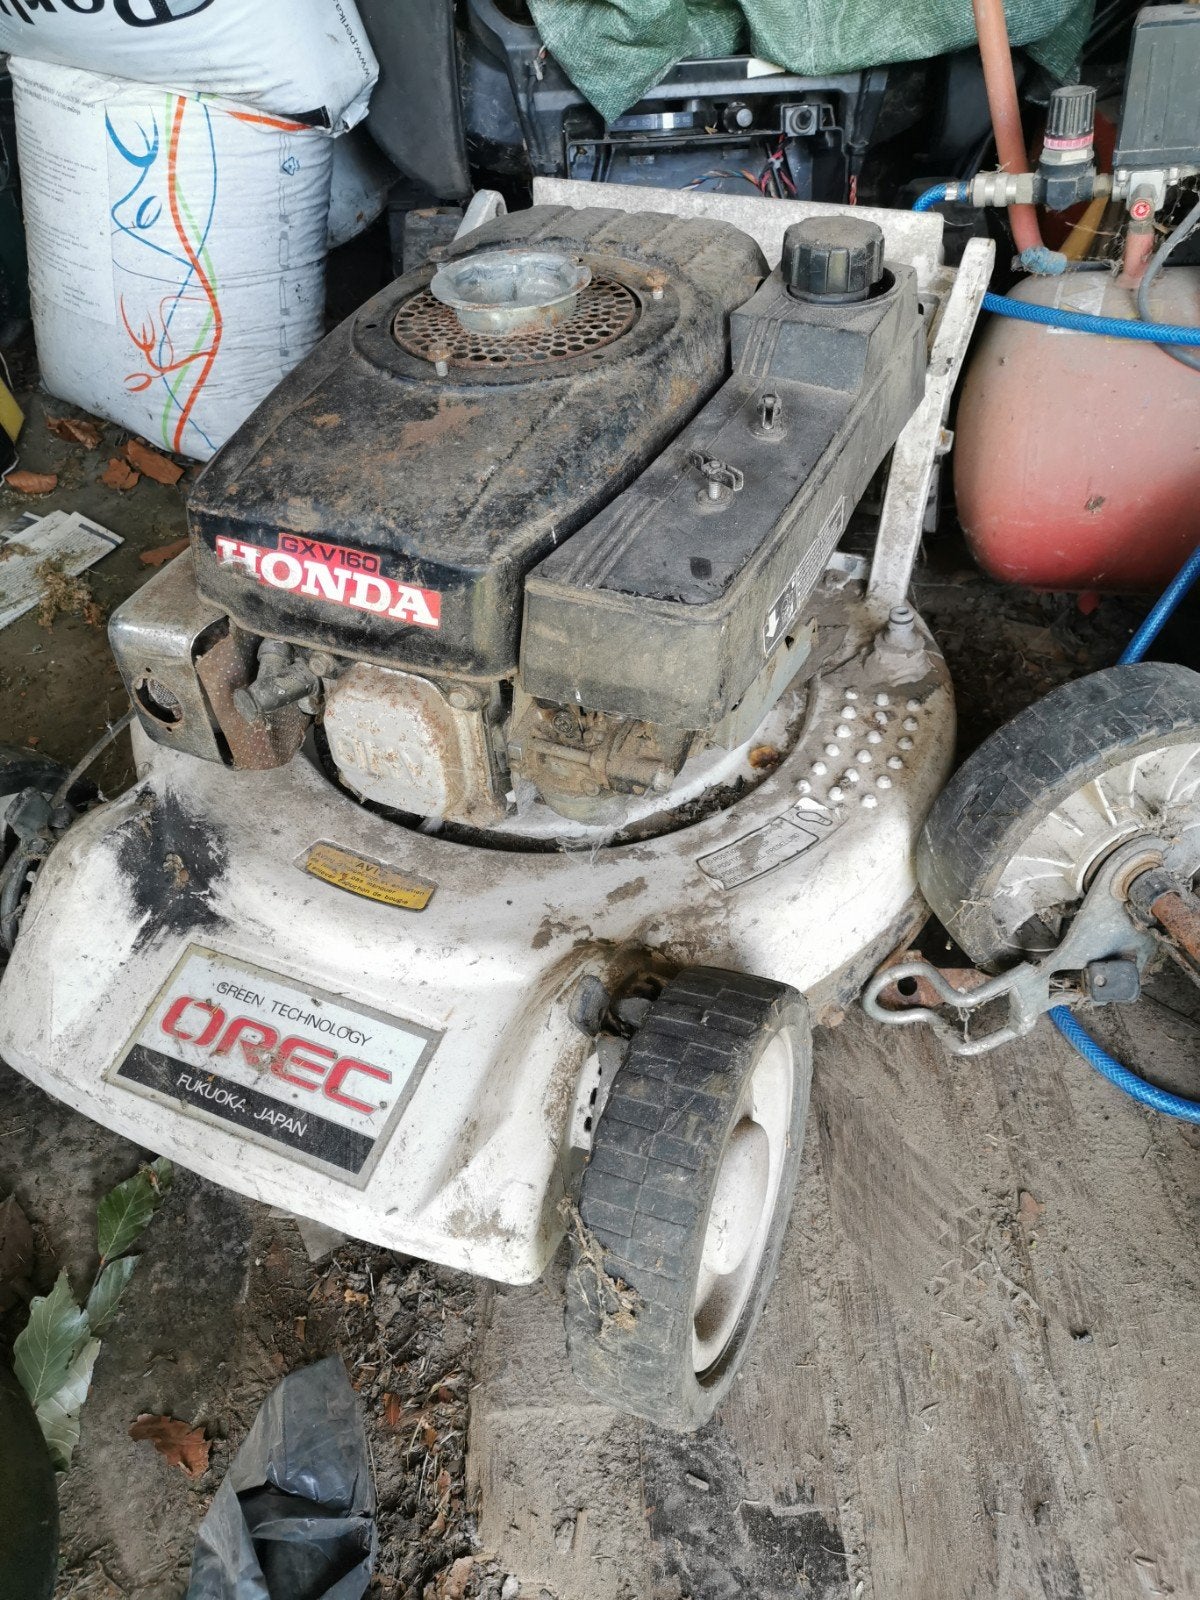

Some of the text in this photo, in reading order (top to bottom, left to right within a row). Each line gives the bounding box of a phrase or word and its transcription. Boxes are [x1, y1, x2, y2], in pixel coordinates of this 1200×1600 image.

[217, 538, 439, 627] HONDA
[281, 536, 378, 573] GXV160
[355, 862, 385, 877] AVI
[216, 981, 373, 1048] GREEN TECHNOLOGY
[160, 995, 394, 1115] OREC
[176, 1074, 308, 1138] FUKUOKA JAPAN
